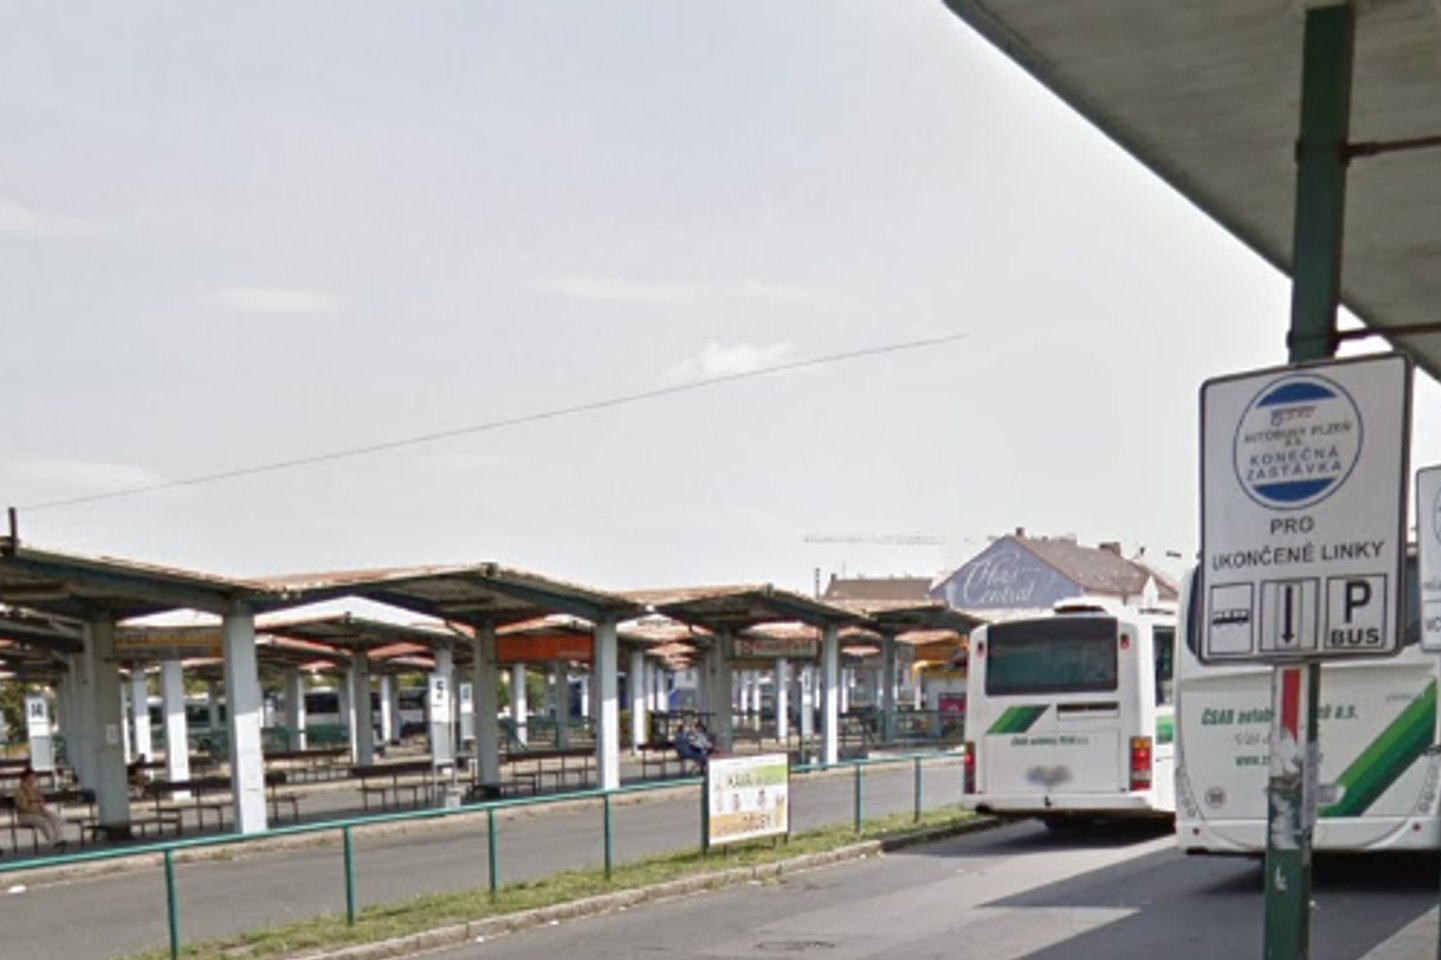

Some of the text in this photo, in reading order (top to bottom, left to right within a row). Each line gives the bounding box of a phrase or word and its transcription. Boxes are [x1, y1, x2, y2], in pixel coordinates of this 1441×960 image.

[1250, 445, 1339, 467] KONEČNÁ
[1246, 460, 1341, 481] ZASTÁVKA
[1270, 515, 1315, 535] PRO
[1211, 540, 1386, 571] UKONČENÉ LINKY
[1343, 580, 1373, 625] P
[1330, 627, 1380, 646] BUS
